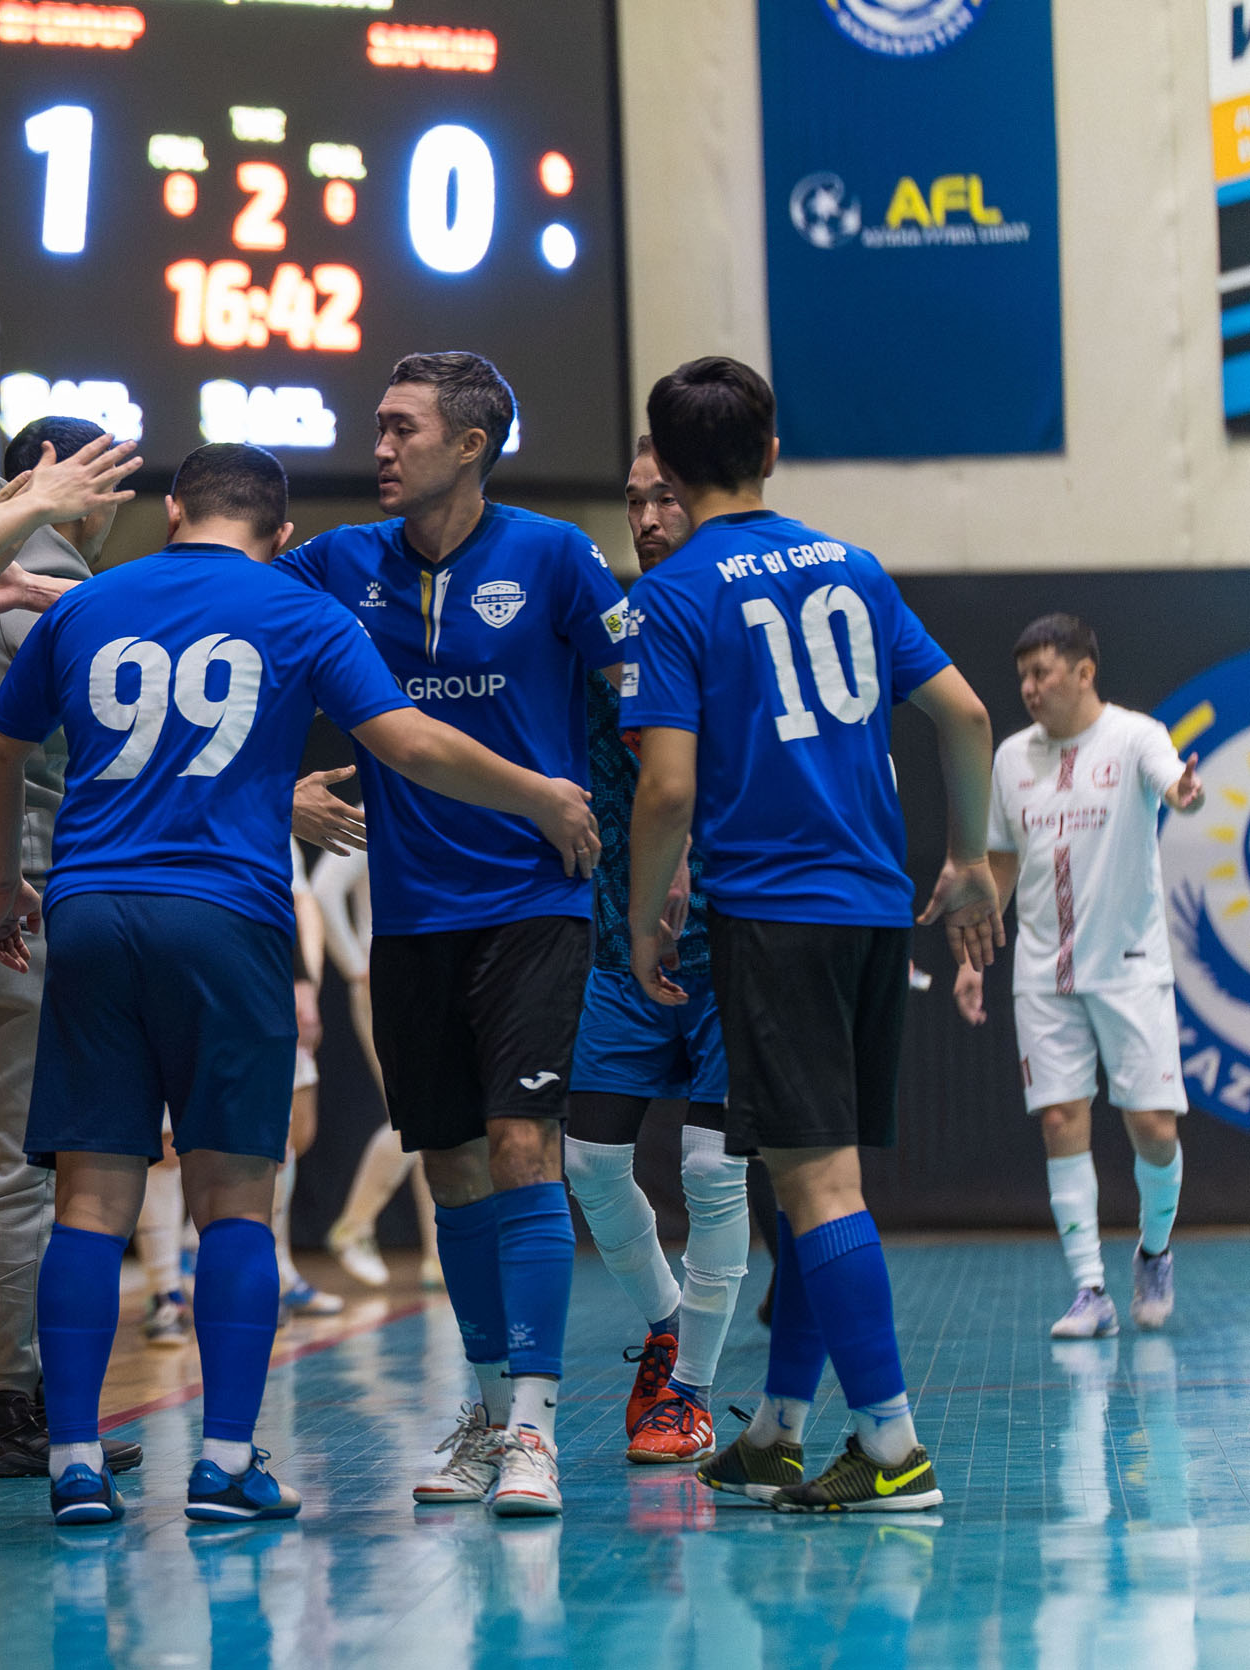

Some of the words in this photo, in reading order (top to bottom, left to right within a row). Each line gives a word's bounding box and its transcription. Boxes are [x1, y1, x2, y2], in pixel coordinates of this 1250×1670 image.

[25, 105, 94, 254] 1
[232, 161, 289, 252] 2
[408, 123, 495, 274] 0
[886, 173, 1003, 231] AFL
[164, 258, 363, 353] 16:42
[359, 600, 388, 608] KELME
[716, 554, 763, 583] MFC
[762, 550, 788, 574] BI
[787, 541, 847, 568] GROUP
[89, 632, 263, 781] 99
[406, 674, 507, 700] GROUP
[741, 583, 881, 743] 10
